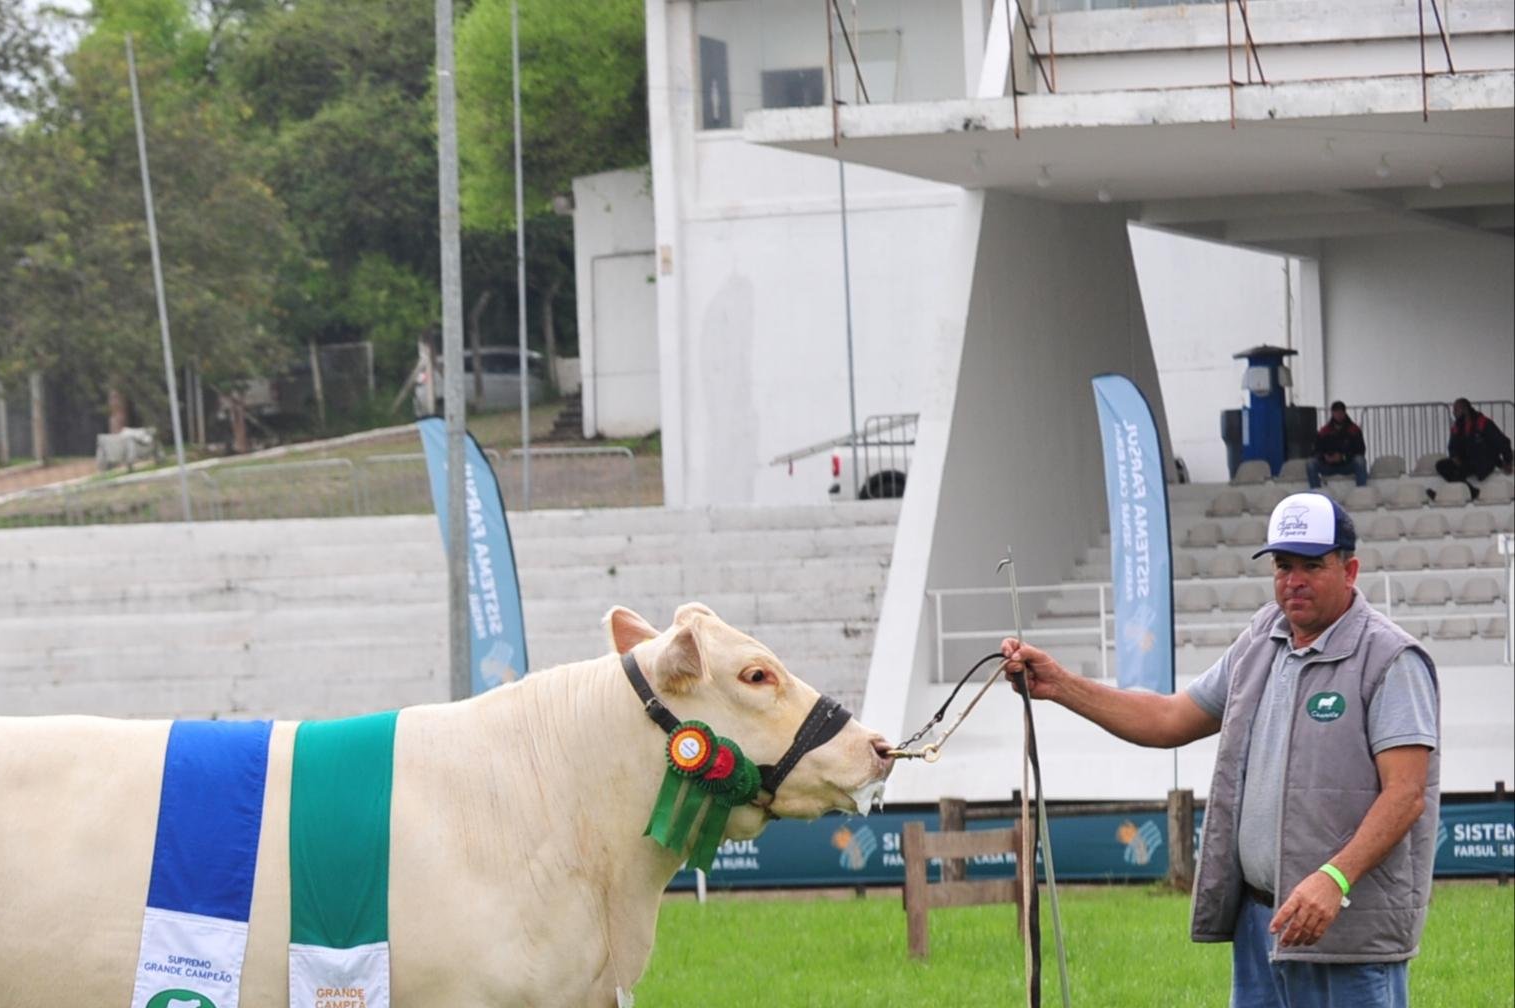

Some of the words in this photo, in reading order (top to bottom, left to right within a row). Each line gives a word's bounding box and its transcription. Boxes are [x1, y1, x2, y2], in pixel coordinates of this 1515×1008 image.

[1454, 845, 1496, 858] FARSUL
[168, 955, 212, 969] SUPREMO
[144, 962, 183, 976] GRANDE
[185, 968, 232, 983] CAMPEÃO
[316, 988, 365, 998] GRANDE
